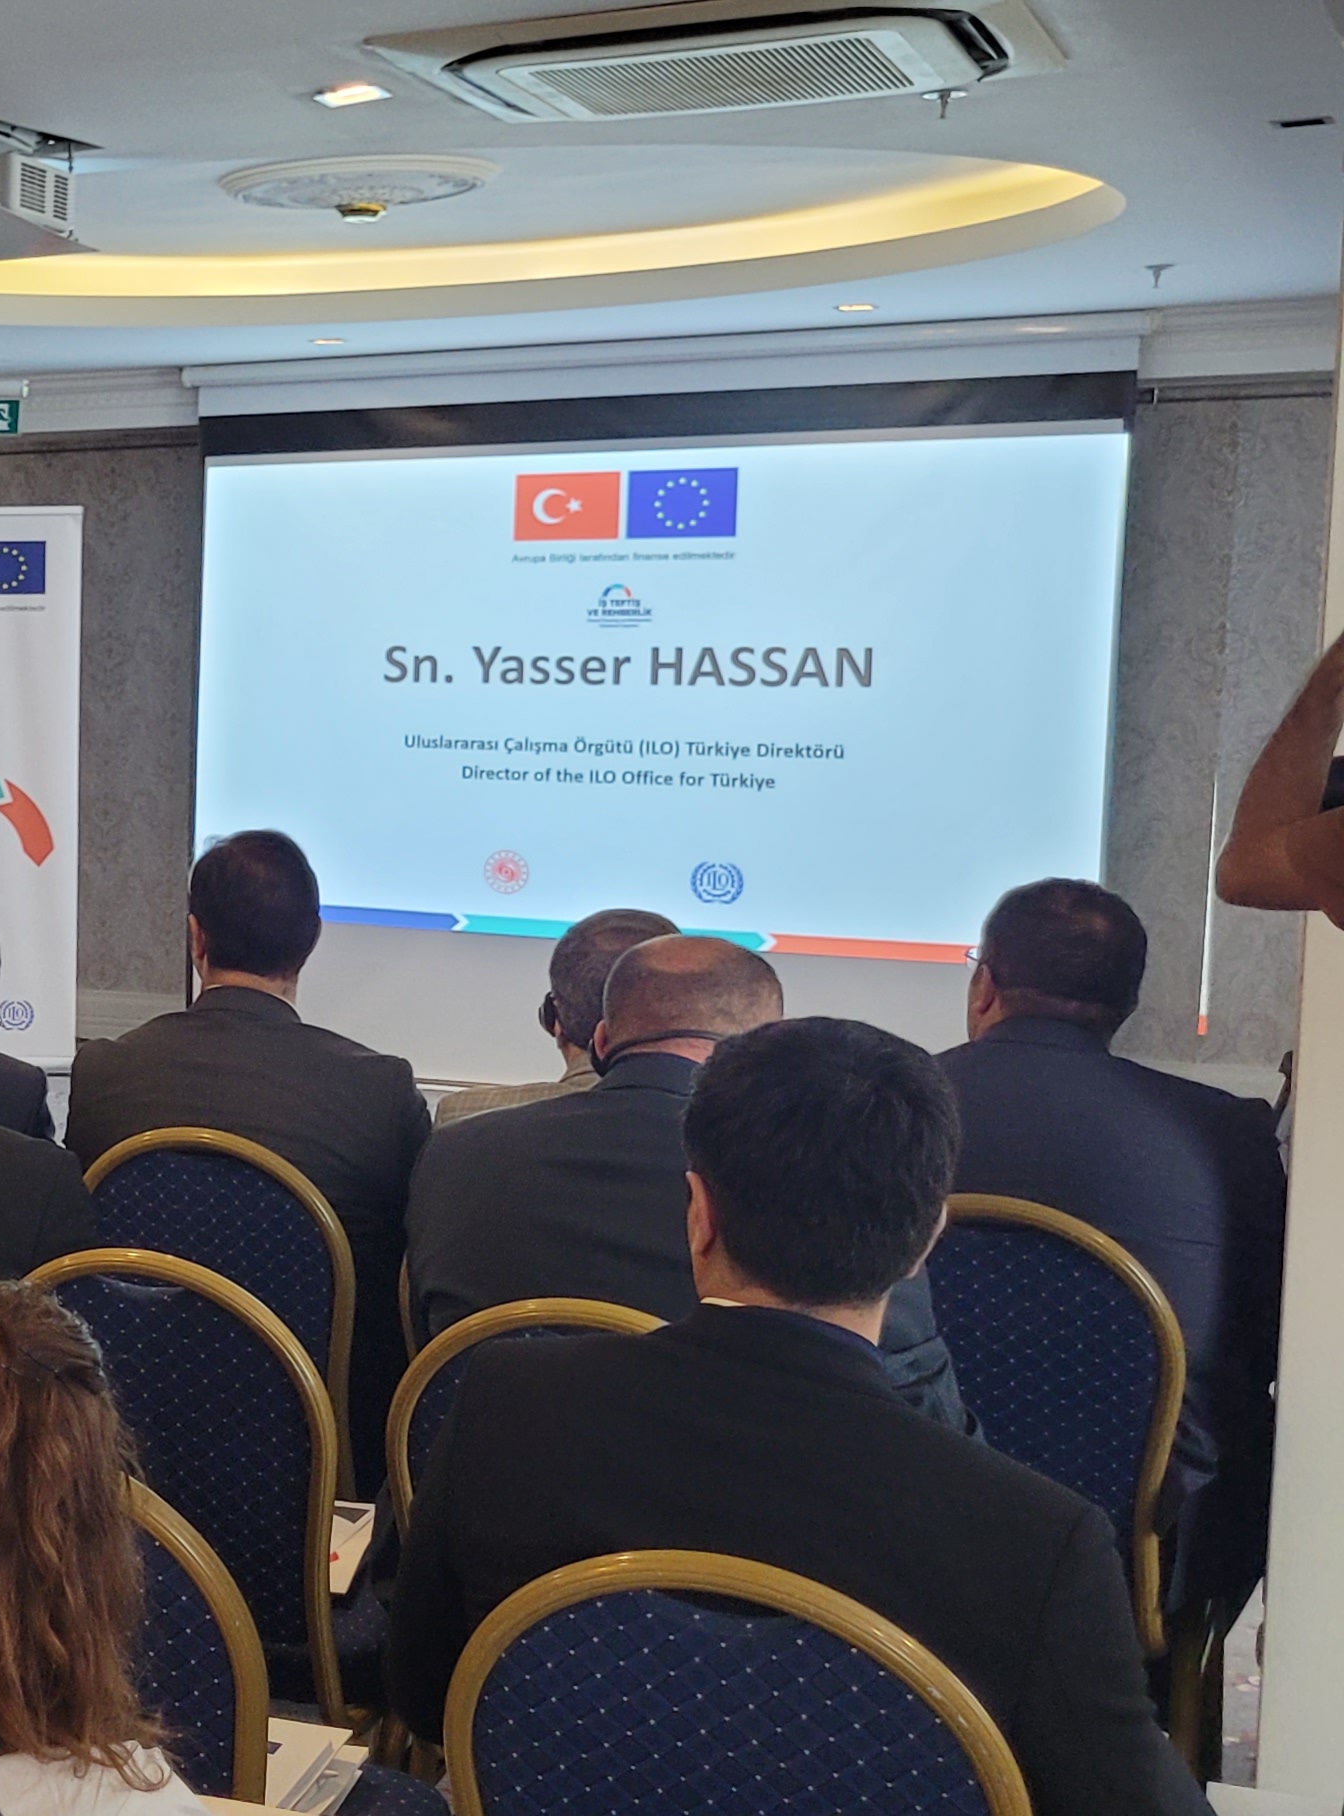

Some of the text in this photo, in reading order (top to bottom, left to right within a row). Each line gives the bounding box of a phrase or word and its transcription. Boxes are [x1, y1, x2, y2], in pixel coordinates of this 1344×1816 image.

[511, 555, 546, 563] Avrupa
[632, 552, 669, 561] finanse
[673, 551, 736, 560] edilmektedir
[602, 607, 652, 616] REHBERLİK
[384, 646, 873, 687] Sn. Yasser HASSAN
[404, 735, 844, 759] Uluslararası Çalışma Örgütü (ILO) Türkiye Direktörü
[462, 766, 775, 791] Director of the ILO Office for Türkiye
